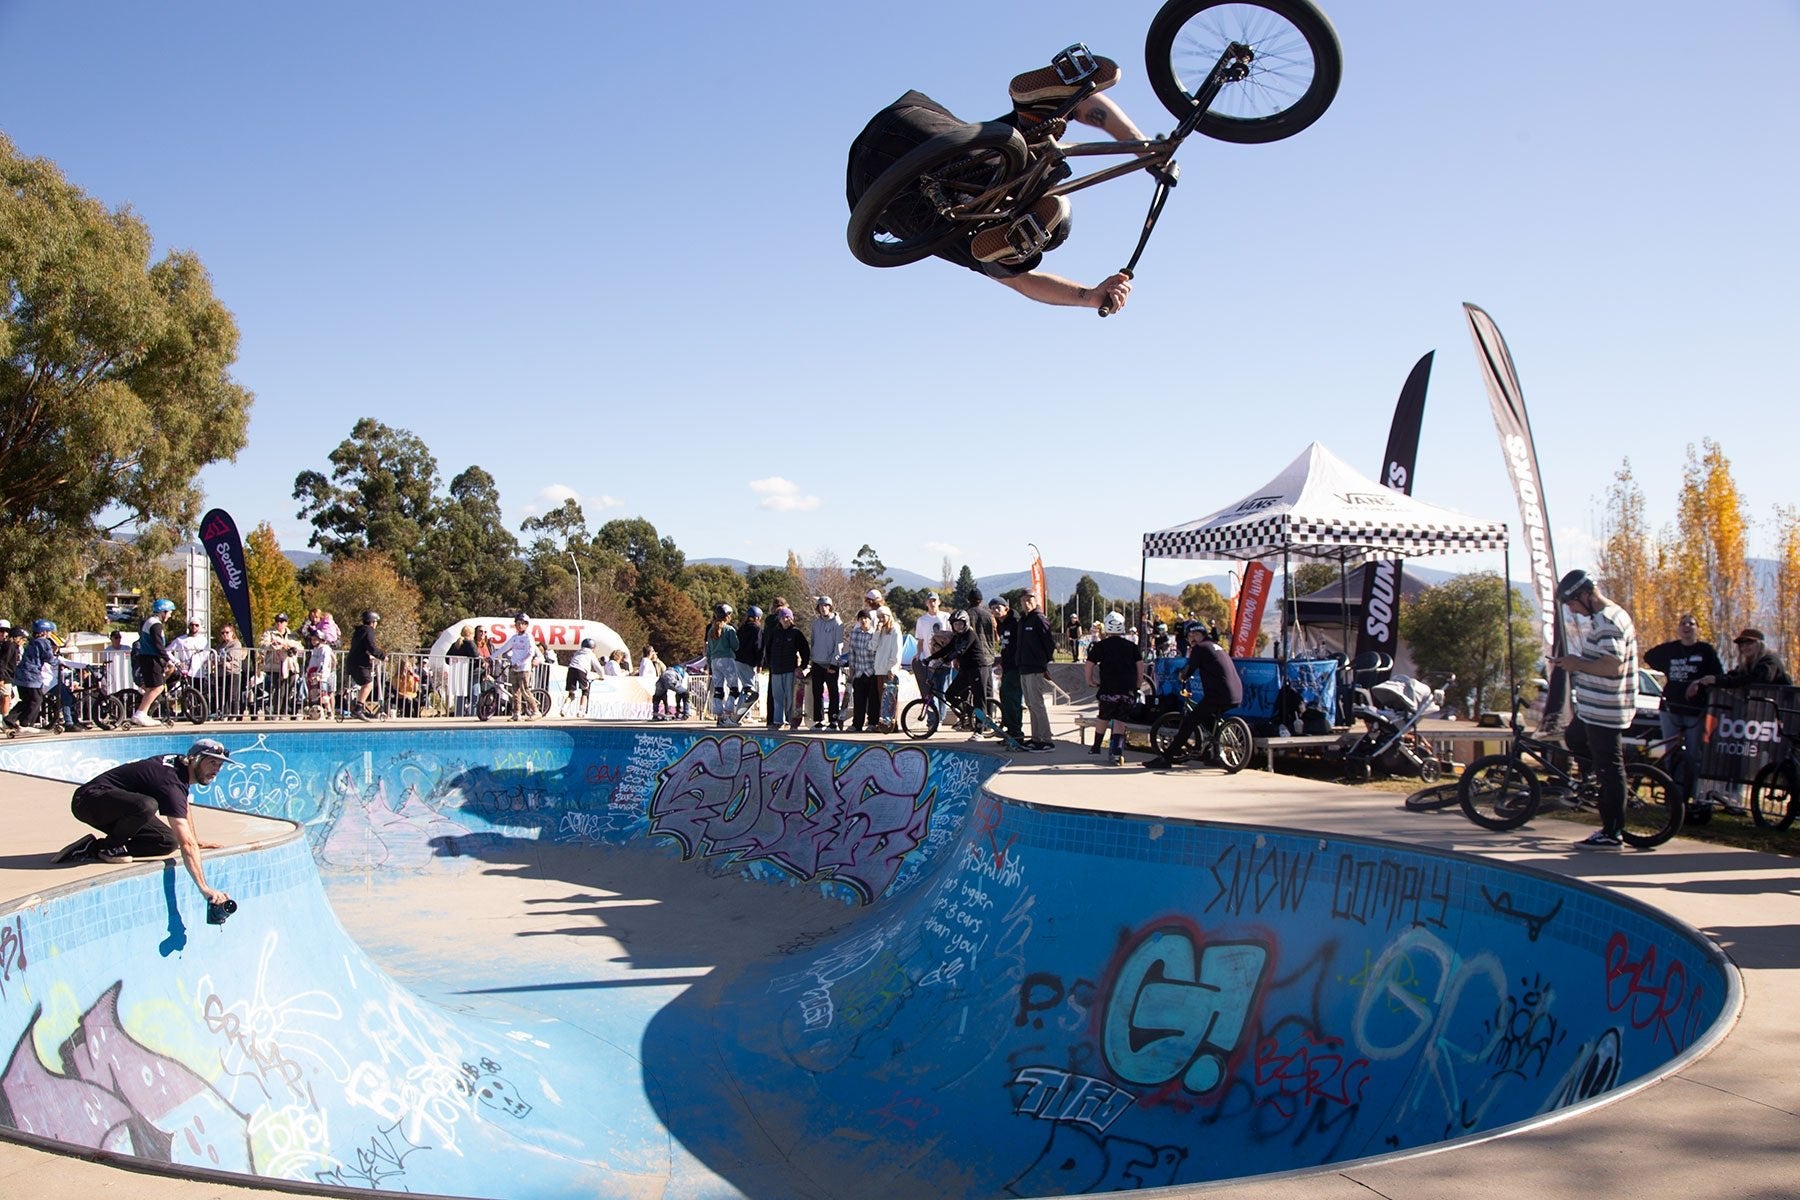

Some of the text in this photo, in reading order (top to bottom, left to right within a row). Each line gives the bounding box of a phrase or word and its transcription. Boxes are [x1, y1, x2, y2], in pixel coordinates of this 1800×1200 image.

[1235, 495, 1284, 513] VANS
[1333, 493, 1395, 506] VANS
[216, 541, 243, 590] Sendy
[490, 623, 585, 645] SART
[1720, 714, 1783, 742] boost
[1717, 741, 1758, 757] mobile
[1204, 844, 1313, 916] SNOW
[962, 880, 993, 911] bigger
[924, 916, 950, 938] than
[957, 911, 983, 933] ears
